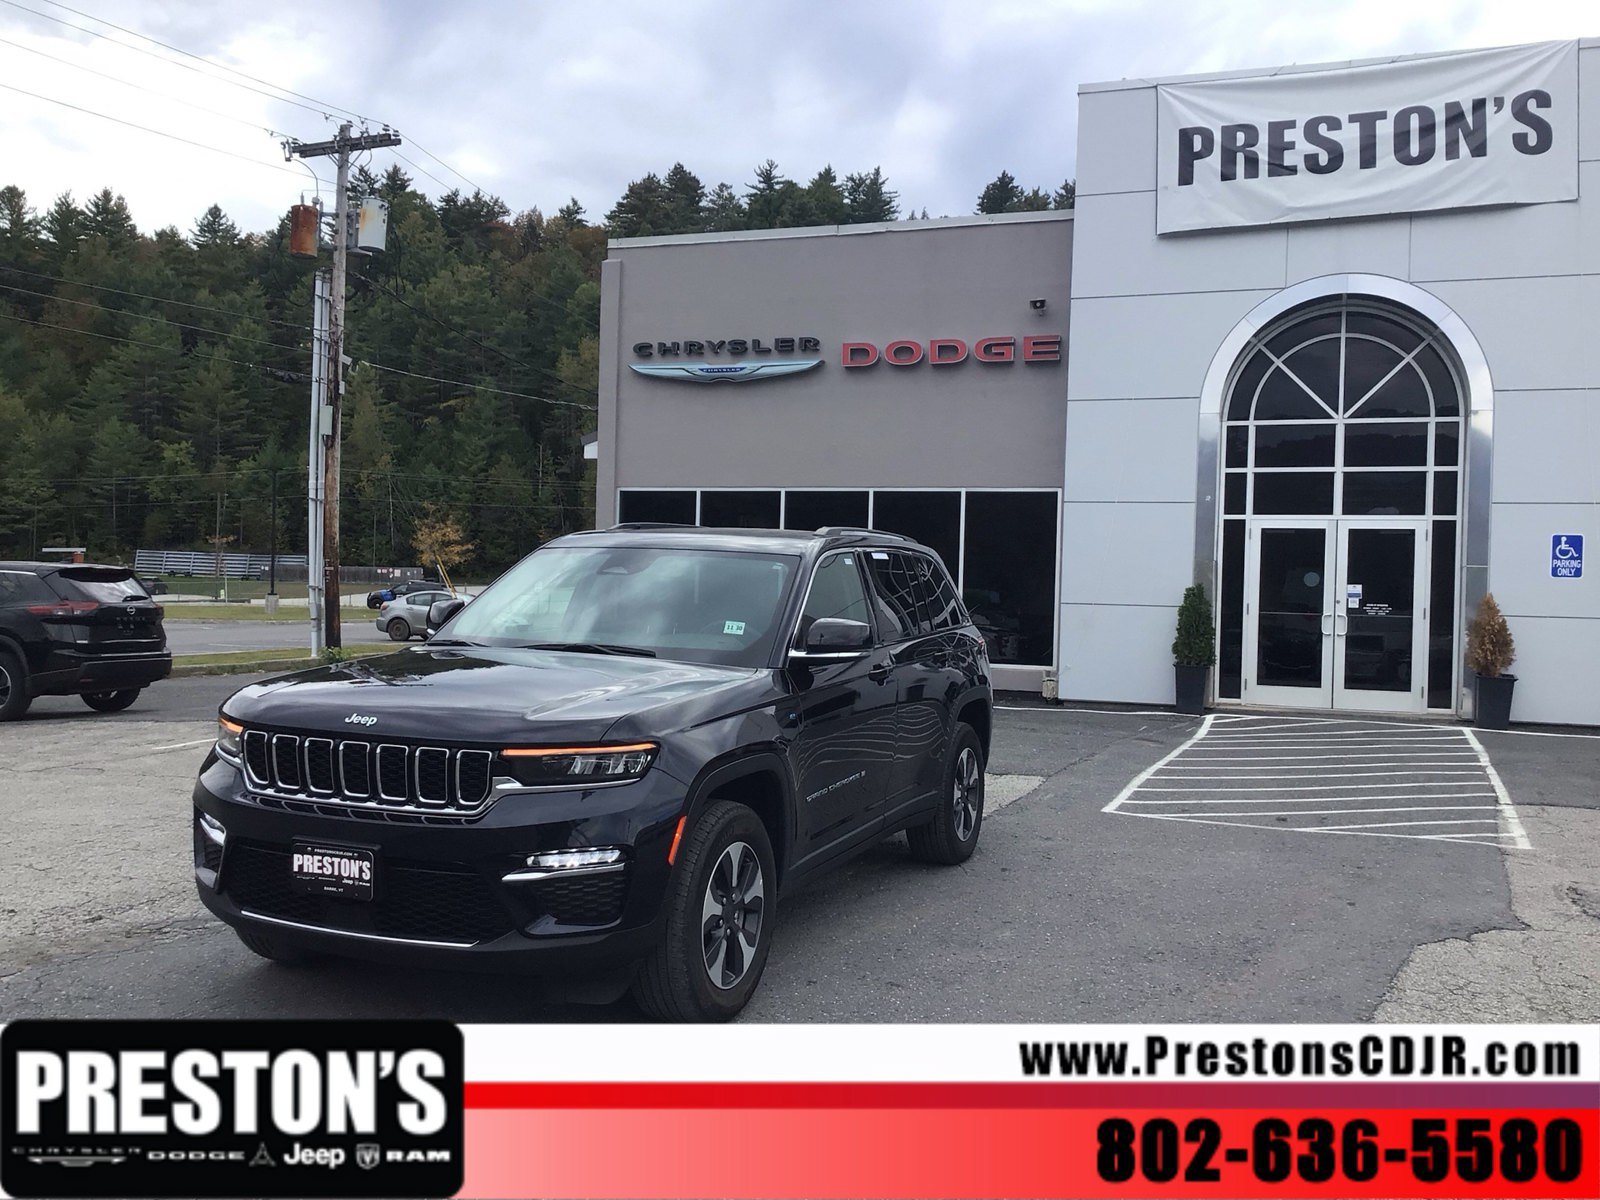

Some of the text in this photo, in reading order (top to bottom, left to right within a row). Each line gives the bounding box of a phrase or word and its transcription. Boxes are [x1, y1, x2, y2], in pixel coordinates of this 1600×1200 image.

[1177, 88, 1553, 187] PRESTON'S
[632, 336, 821, 358] CHRYSLER
[842, 334, 1062, 368] DODGE
[1552, 559, 1582, 568] PARKING
[1557, 567, 1576, 576] ONLY
[344, 712, 378, 727] Jeep
[293, 853, 371, 881] PRESTON'S
